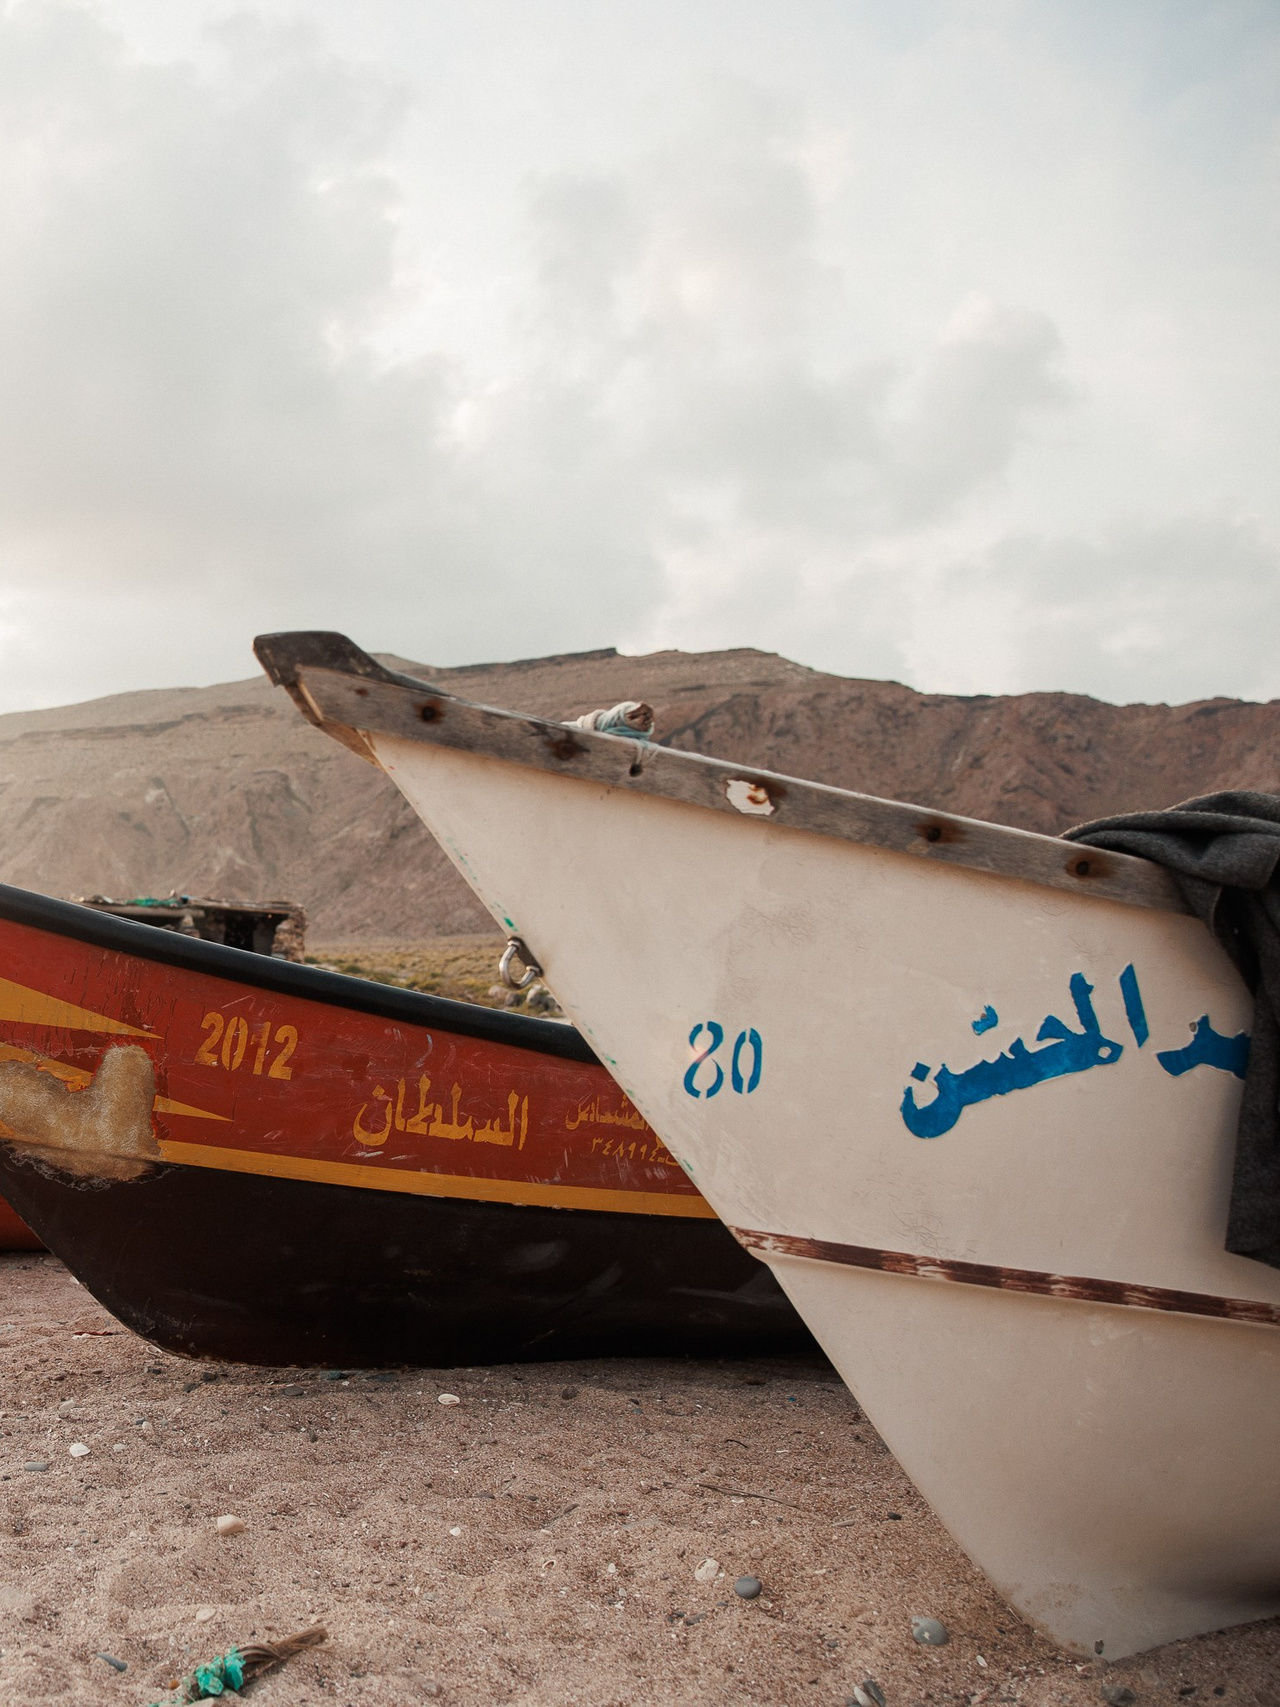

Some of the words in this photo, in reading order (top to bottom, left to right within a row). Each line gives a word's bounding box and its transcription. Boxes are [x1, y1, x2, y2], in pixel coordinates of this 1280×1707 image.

[194, 1011, 298, 1080] 2012
[683, 1020, 762, 1099] 80
[353, 1073, 528, 1150] السلطان
